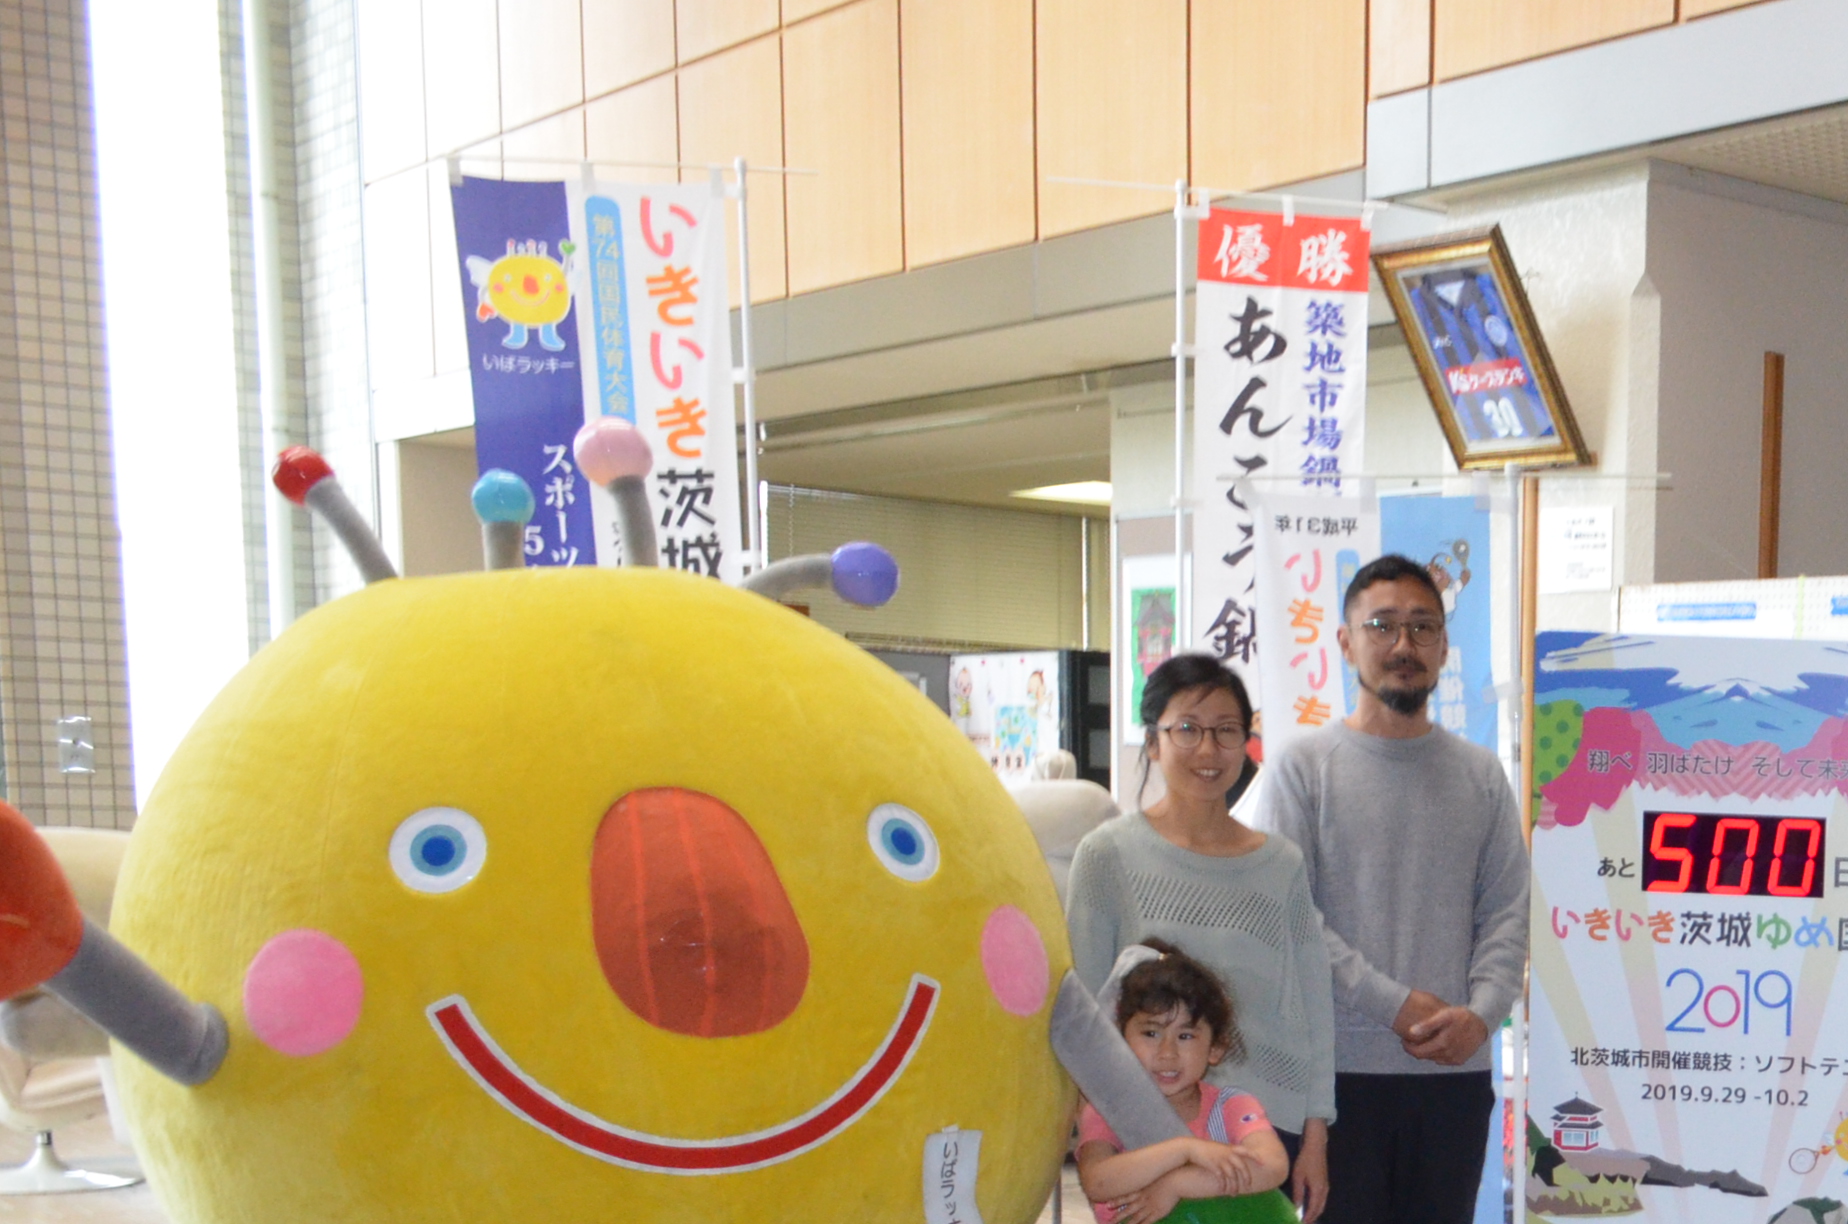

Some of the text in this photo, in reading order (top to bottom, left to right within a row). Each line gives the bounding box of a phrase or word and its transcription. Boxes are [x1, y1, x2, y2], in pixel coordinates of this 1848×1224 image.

[1213, 223, 1354, 287] 優勝
[482, 354, 576, 374] いばラッキー
[1588, 750, 1632, 774] 翔べ
[1647, 751, 1735, 776] 羽ばたけ
[1597, 855, 1636, 880] あと
[1648, 813, 1821, 897] 500
[1665, 967, 1793, 1038] 2019
[1641, 1083, 1747, 1106] 2019.9.29
